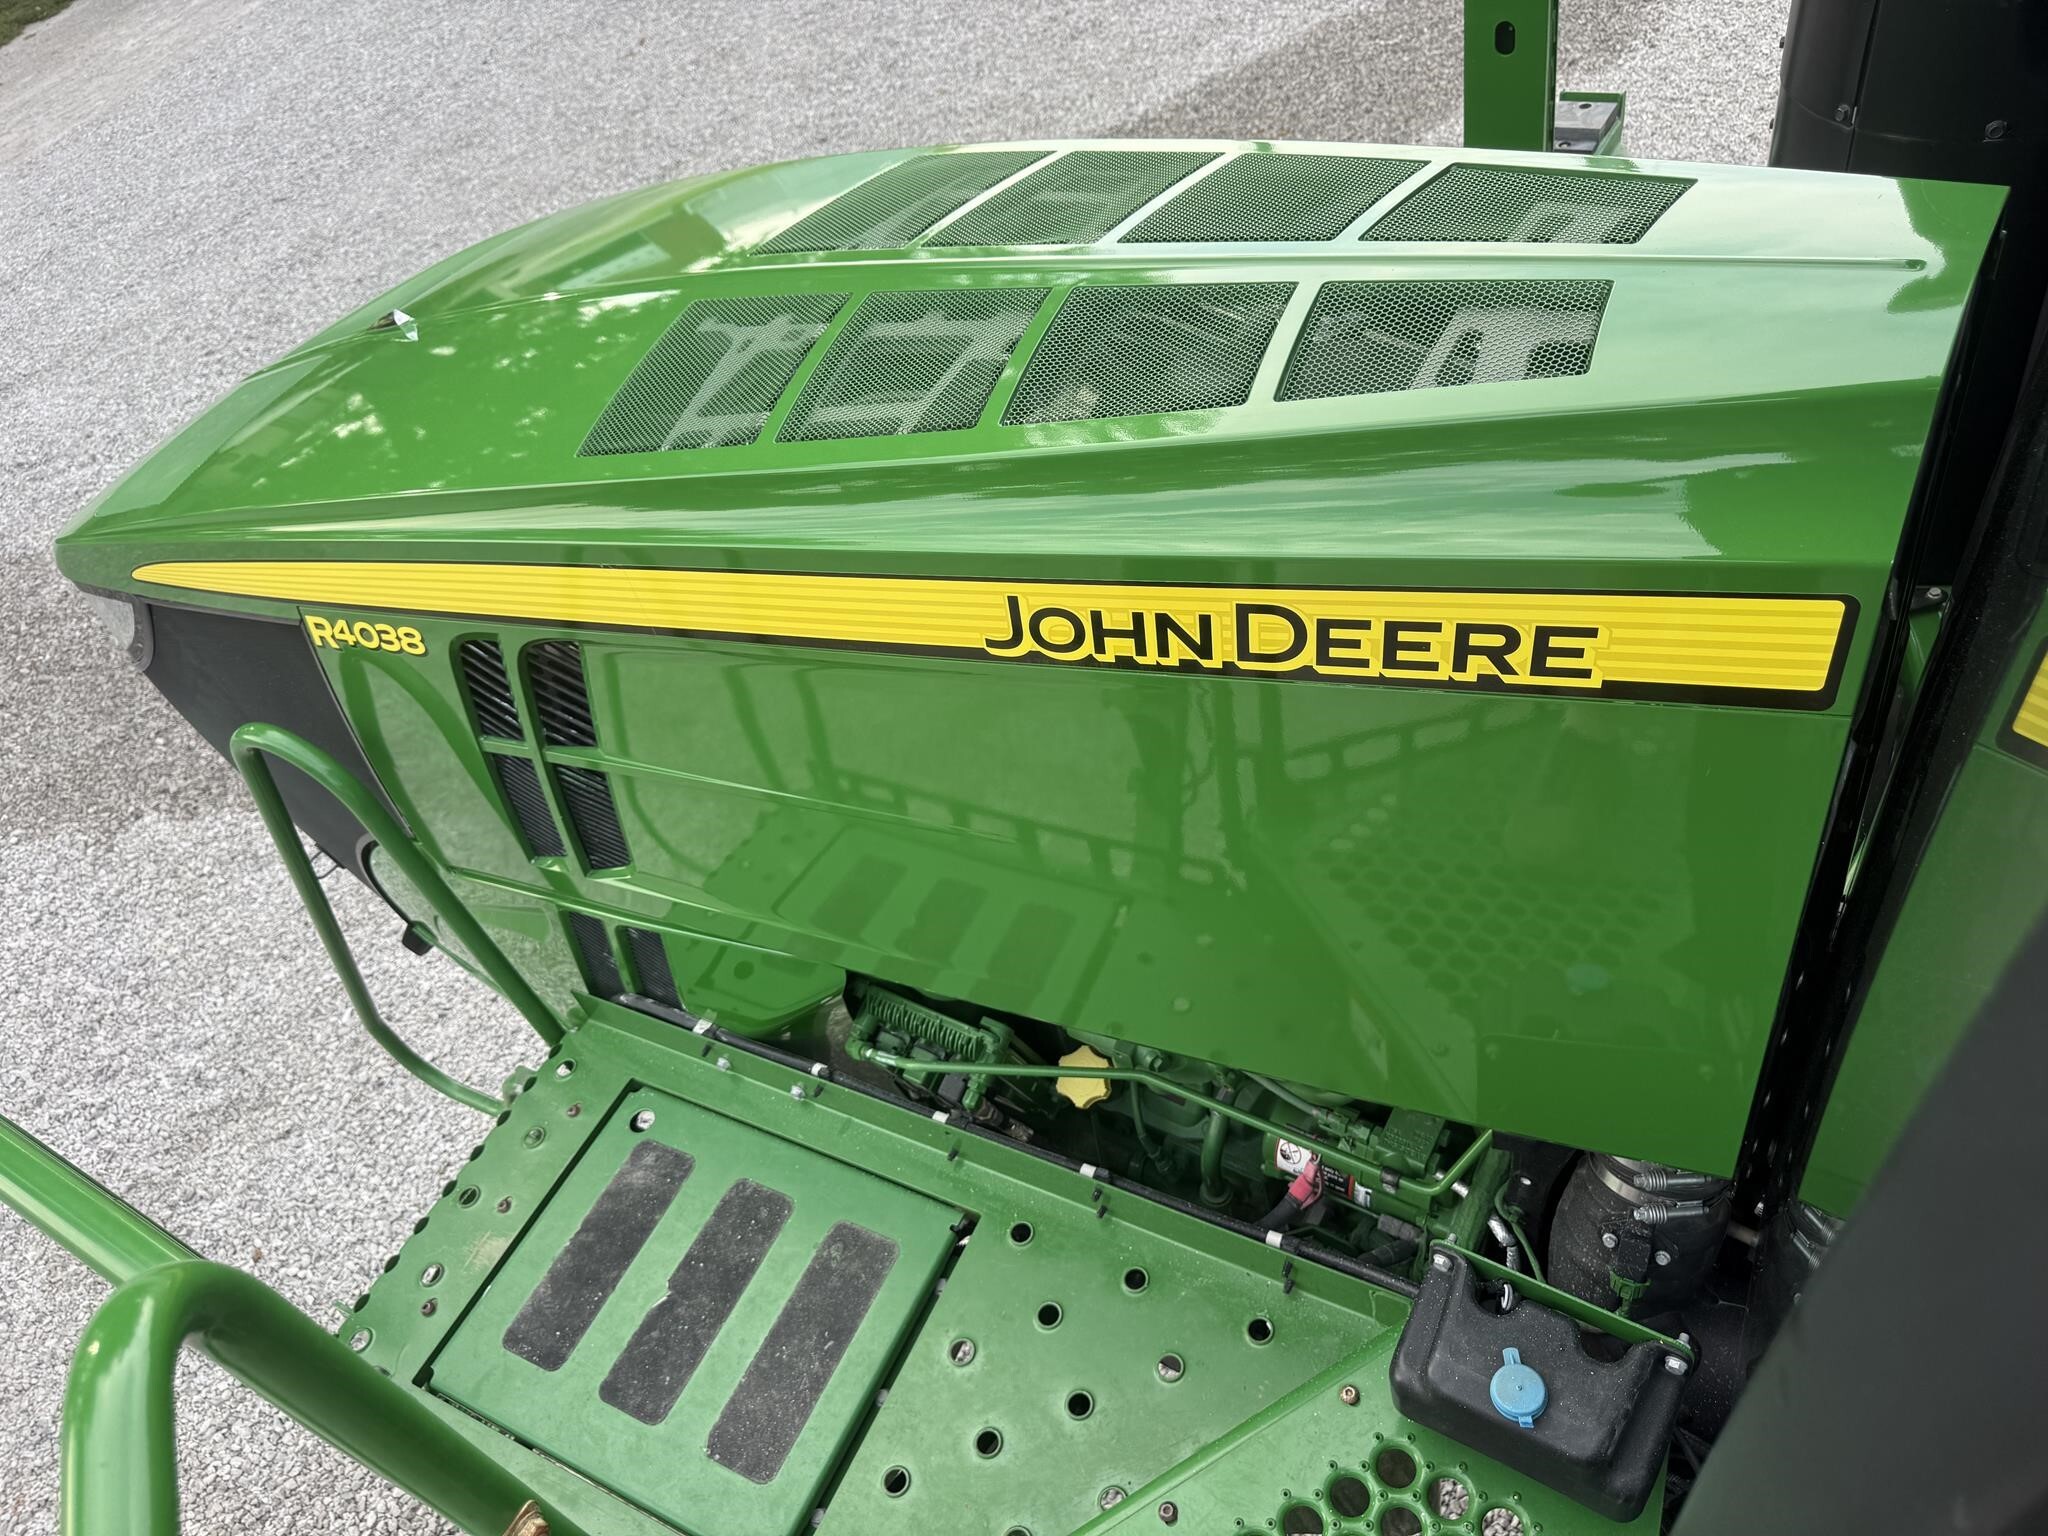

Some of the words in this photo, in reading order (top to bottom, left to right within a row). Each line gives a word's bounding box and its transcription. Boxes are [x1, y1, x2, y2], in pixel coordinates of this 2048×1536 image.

[305, 614, 427, 655] R4038
[985, 594, 1216, 663] JOHN
[1235, 602, 1601, 682] DEERE
